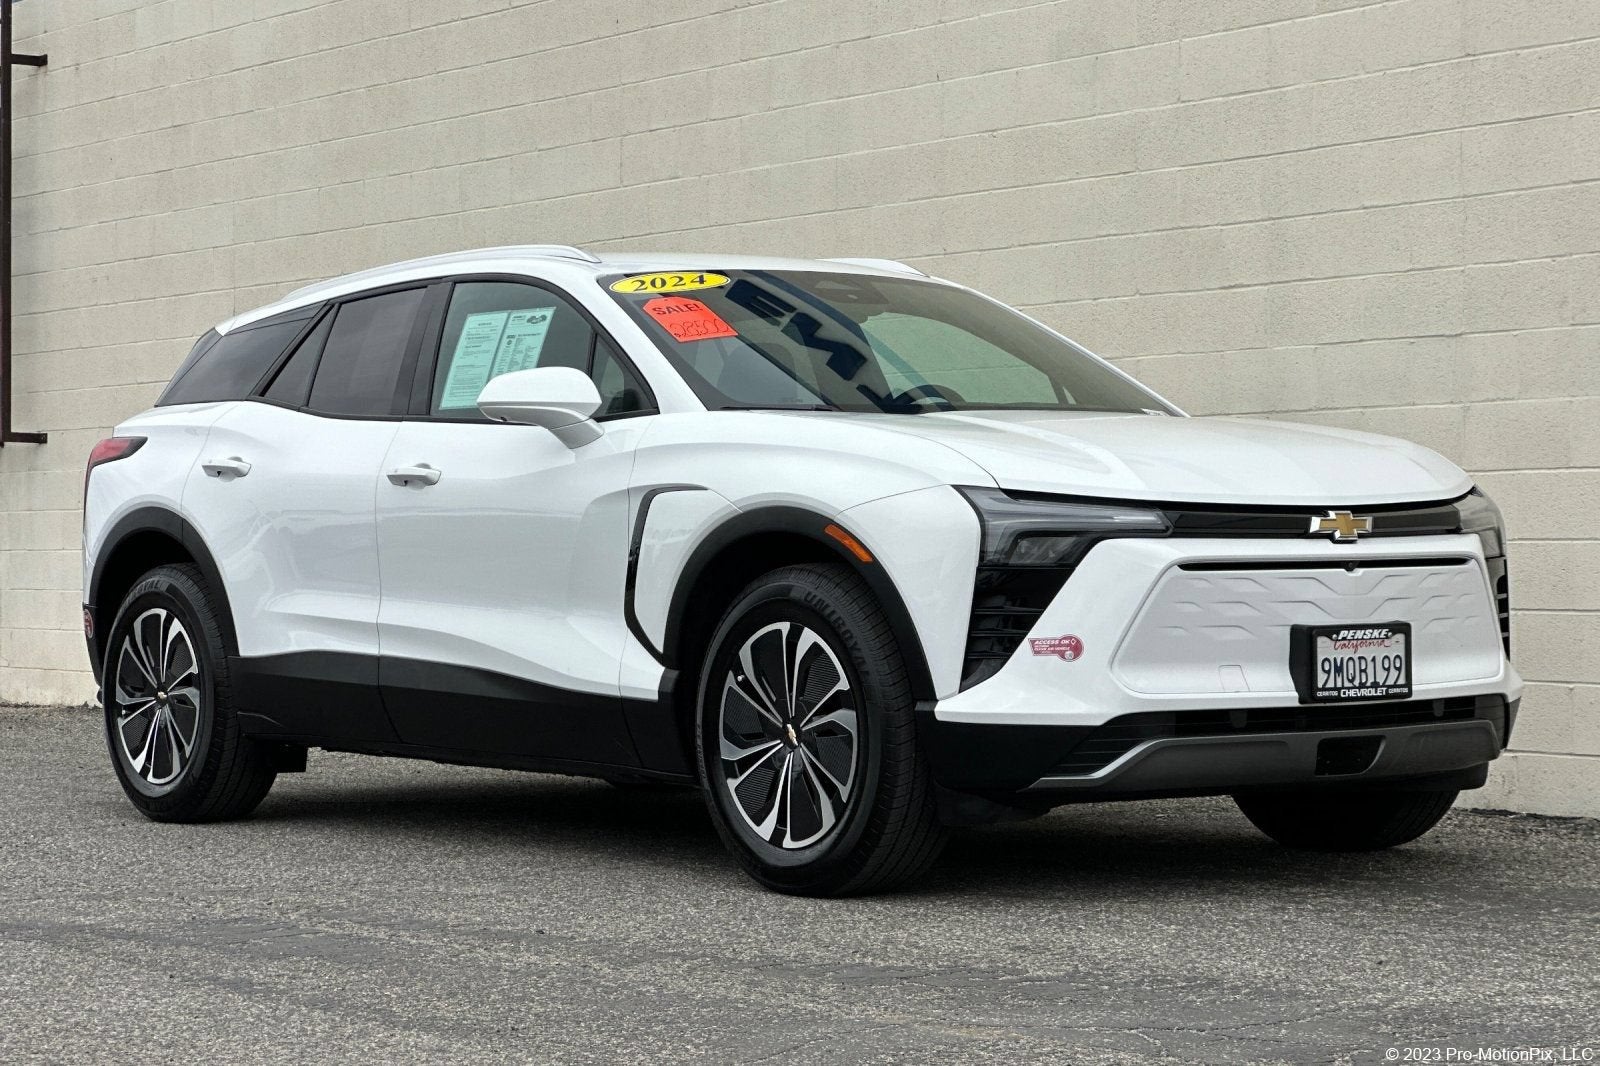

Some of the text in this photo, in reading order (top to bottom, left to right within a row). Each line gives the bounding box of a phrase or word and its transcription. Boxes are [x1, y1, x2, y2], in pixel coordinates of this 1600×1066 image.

[631, 274, 707, 292] 2024
[652, 303, 703, 315] SALE!
[1338, 629, 1390, 640] PENSKE
[1321, 654, 1402, 688] 9MQB199
[1340, 687, 1388, 697] CHEVROLET
